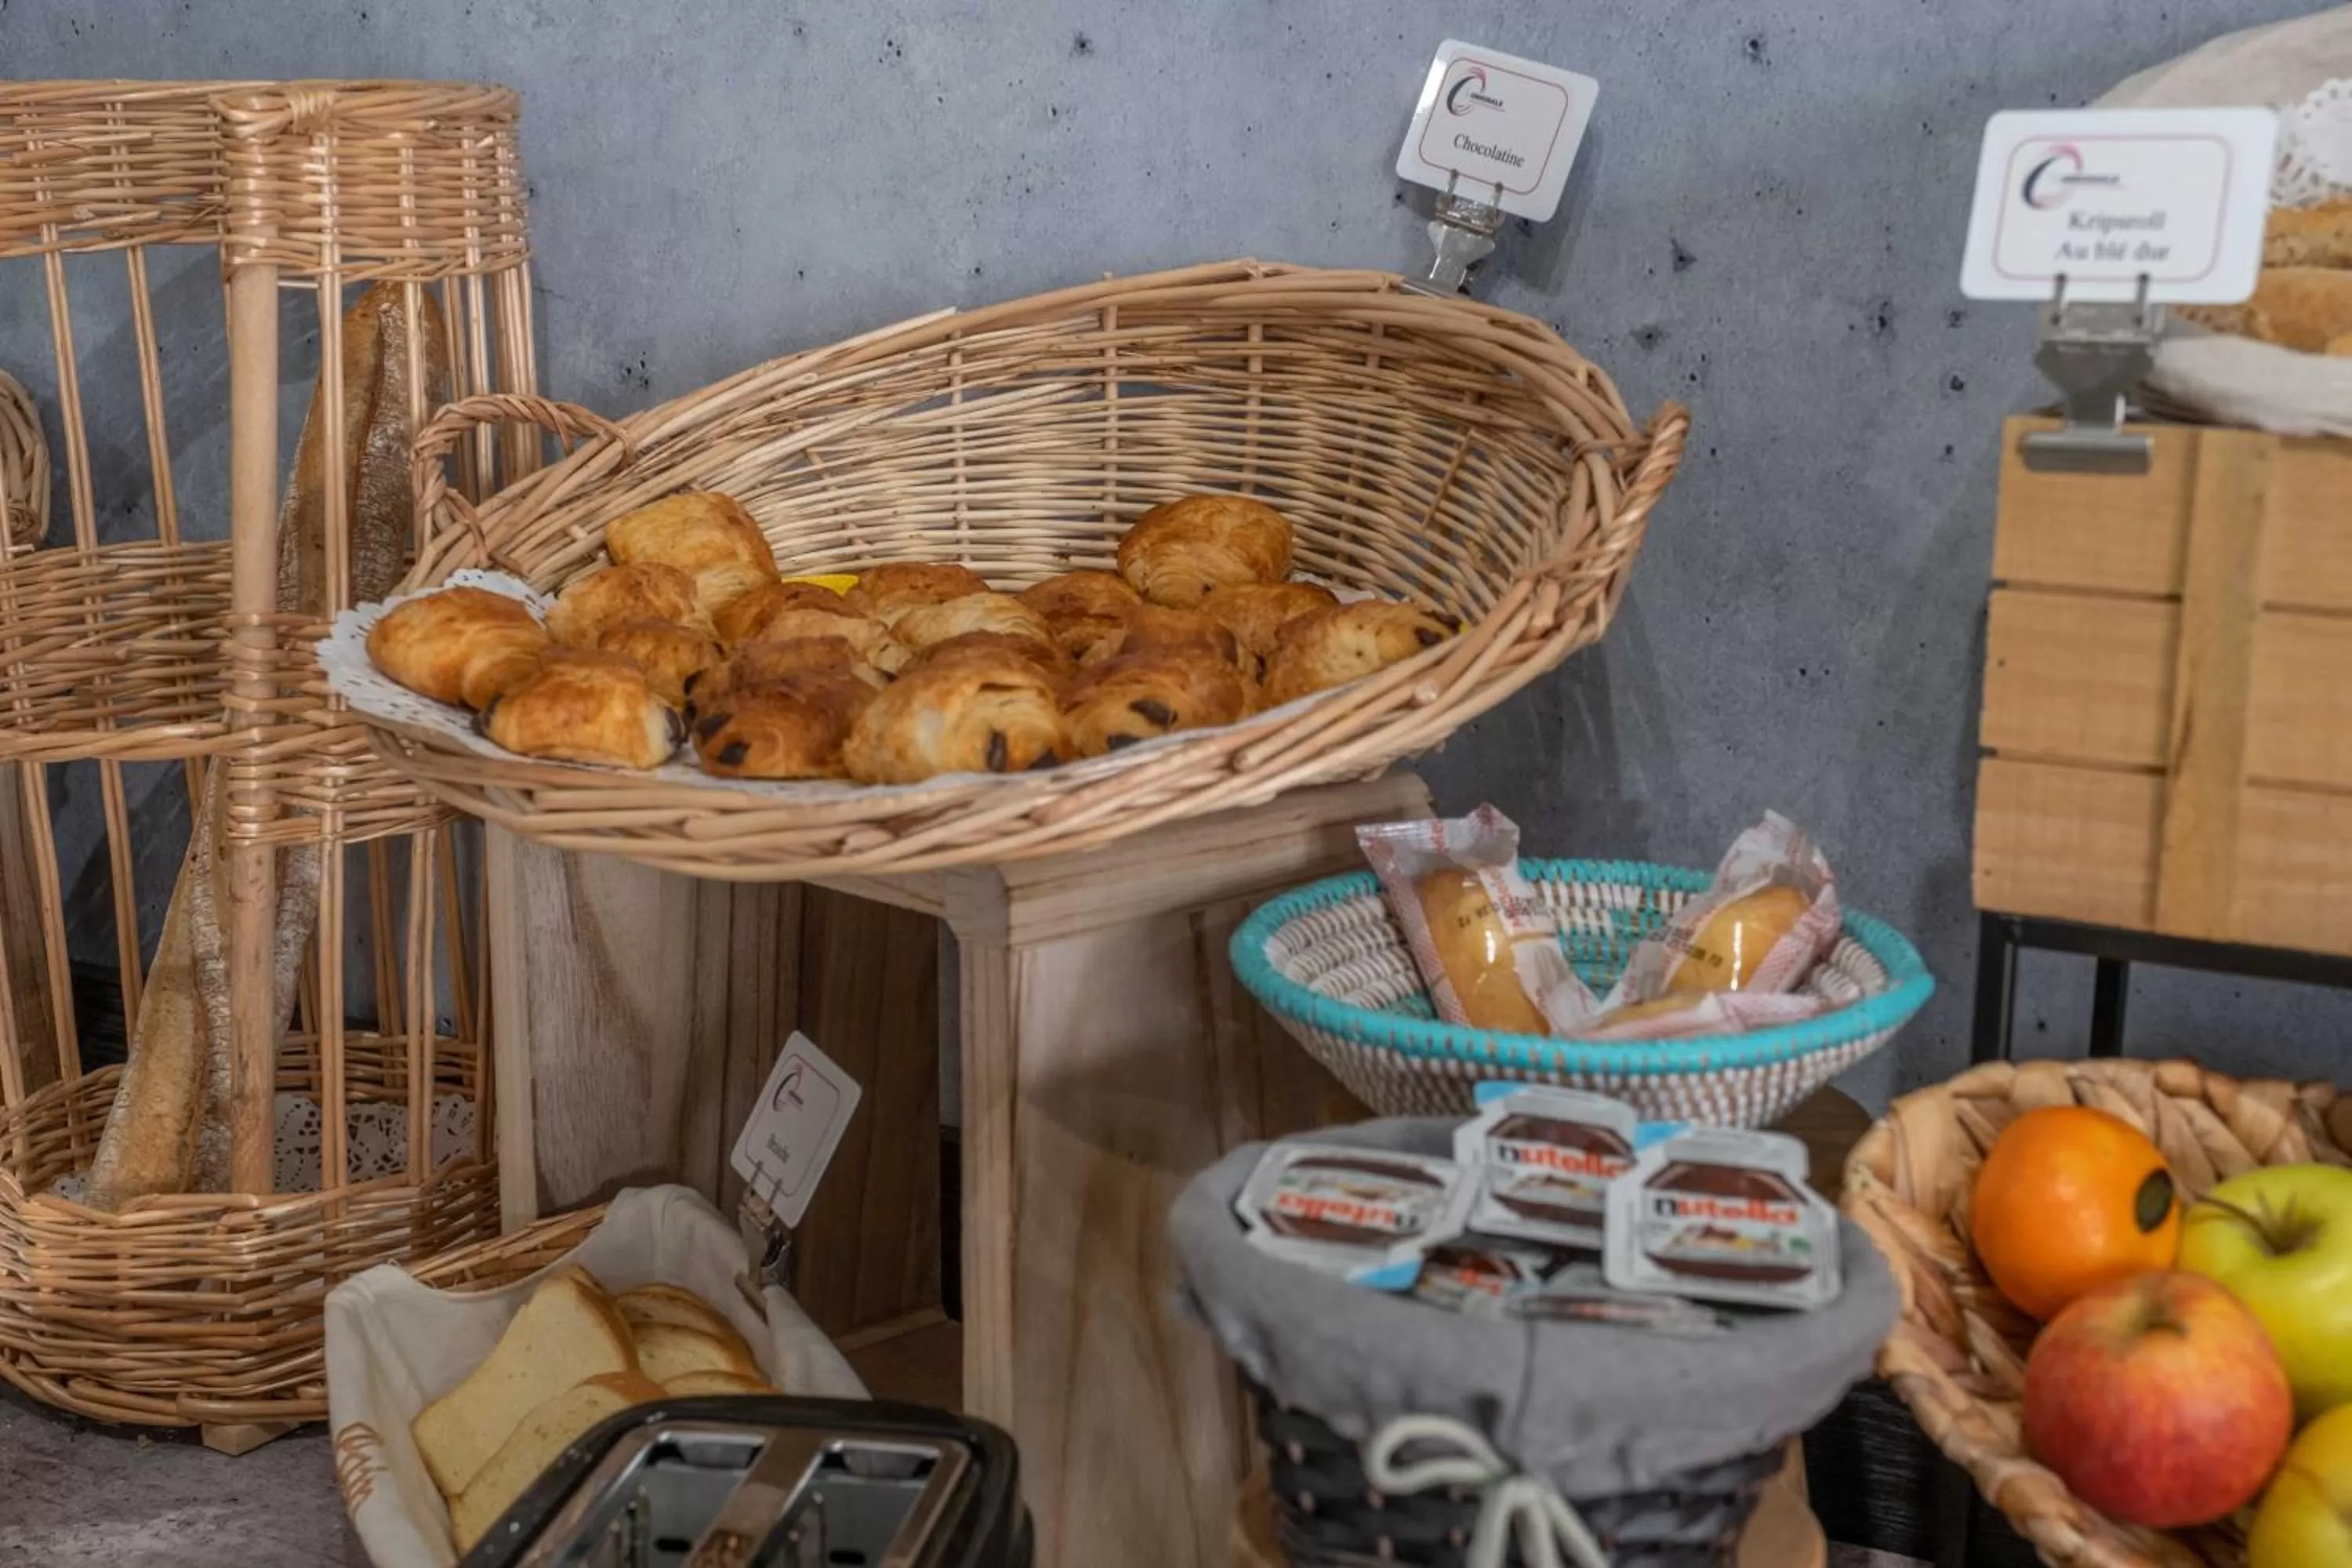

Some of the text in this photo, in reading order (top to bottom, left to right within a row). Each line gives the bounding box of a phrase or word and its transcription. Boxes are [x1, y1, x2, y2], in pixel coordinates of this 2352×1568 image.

[1453, 132, 1526, 168] Chocolatine
[2053, 241, 2089, 261] Au
[1654, 1197, 1799, 1227] nutella
